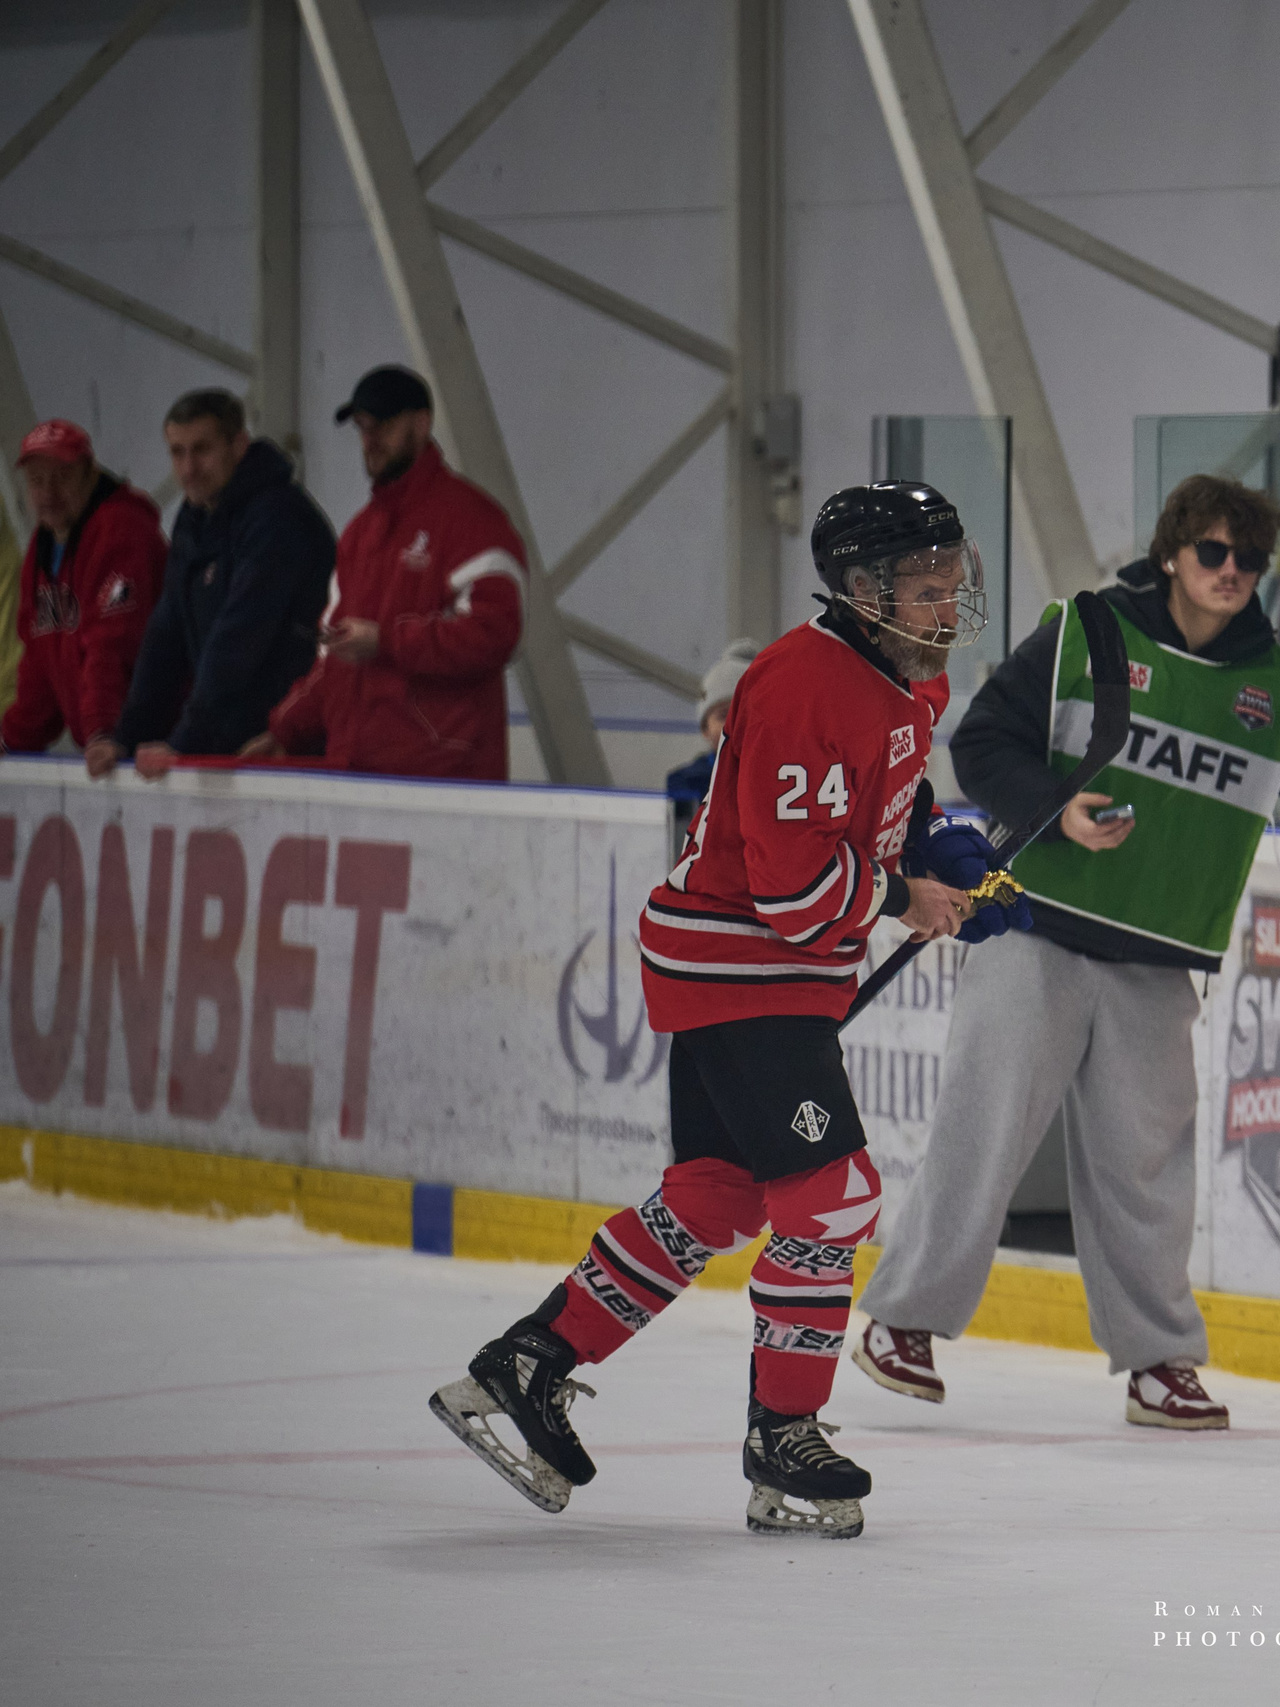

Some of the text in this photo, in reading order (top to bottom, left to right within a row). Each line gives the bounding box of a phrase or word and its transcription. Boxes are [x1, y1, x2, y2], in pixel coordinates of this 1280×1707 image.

[928, 511, 955, 524] CCM
[832, 545, 859, 556] CCM
[890, 728, 911, 748] SILK
[892, 740, 911, 761] WAY
[1126, 722, 1248, 792] TAFF
[776, 763, 849, 821] 24
[0, 814, 412, 1140] ONBET
[804, 1104, 819, 1139] TACKLA
